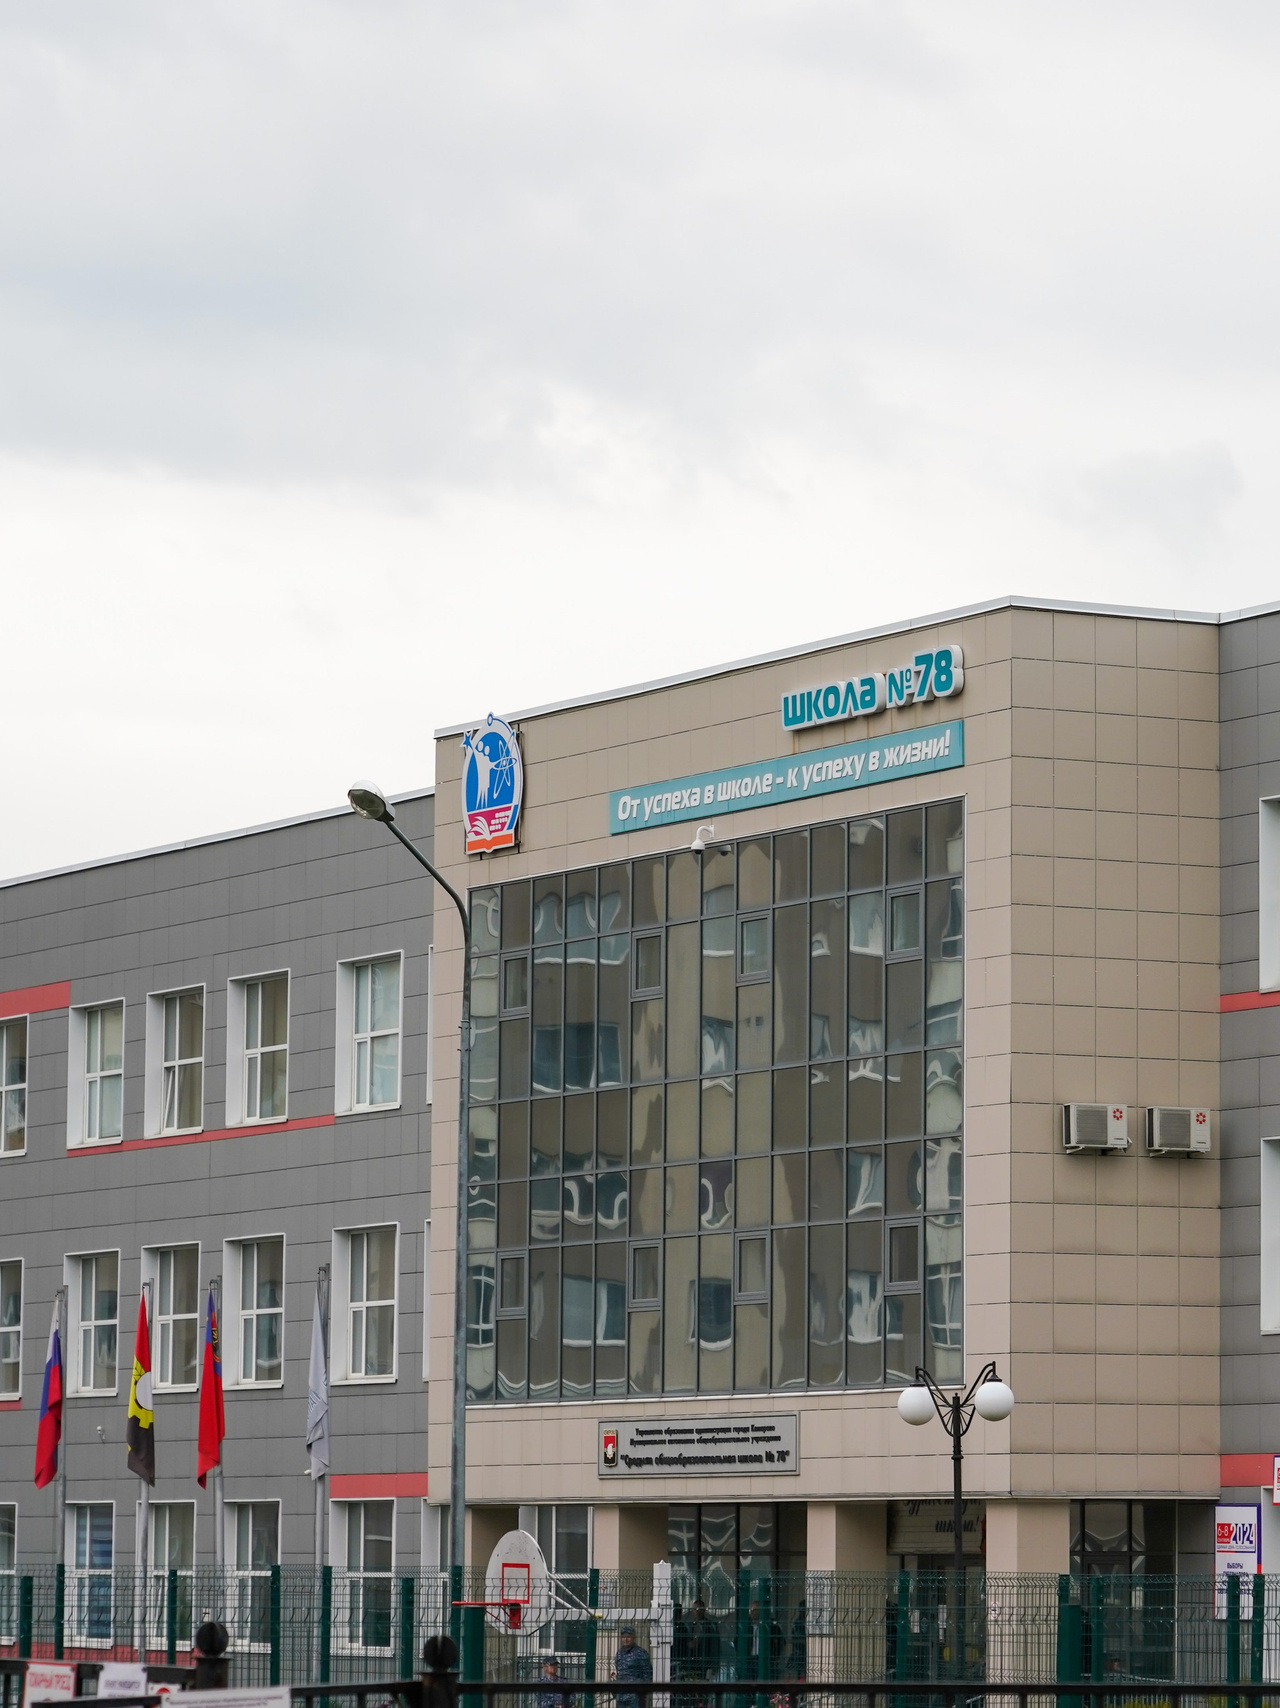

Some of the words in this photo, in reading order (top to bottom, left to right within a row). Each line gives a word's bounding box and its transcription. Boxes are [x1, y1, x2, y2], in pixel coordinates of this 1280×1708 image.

[618, 795, 641, 820] От
[643, 787, 701, 821] успеха
[703, 784, 715, 804] в
[717, 773, 773, 802] школе
[787, 767, 799, 788] к
[802, 753, 866, 791] успеху
[868, 750, 880, 771] в
[883, 729, 951, 769] жизни!
[1230, 1523, 1255, 1545] 2024
